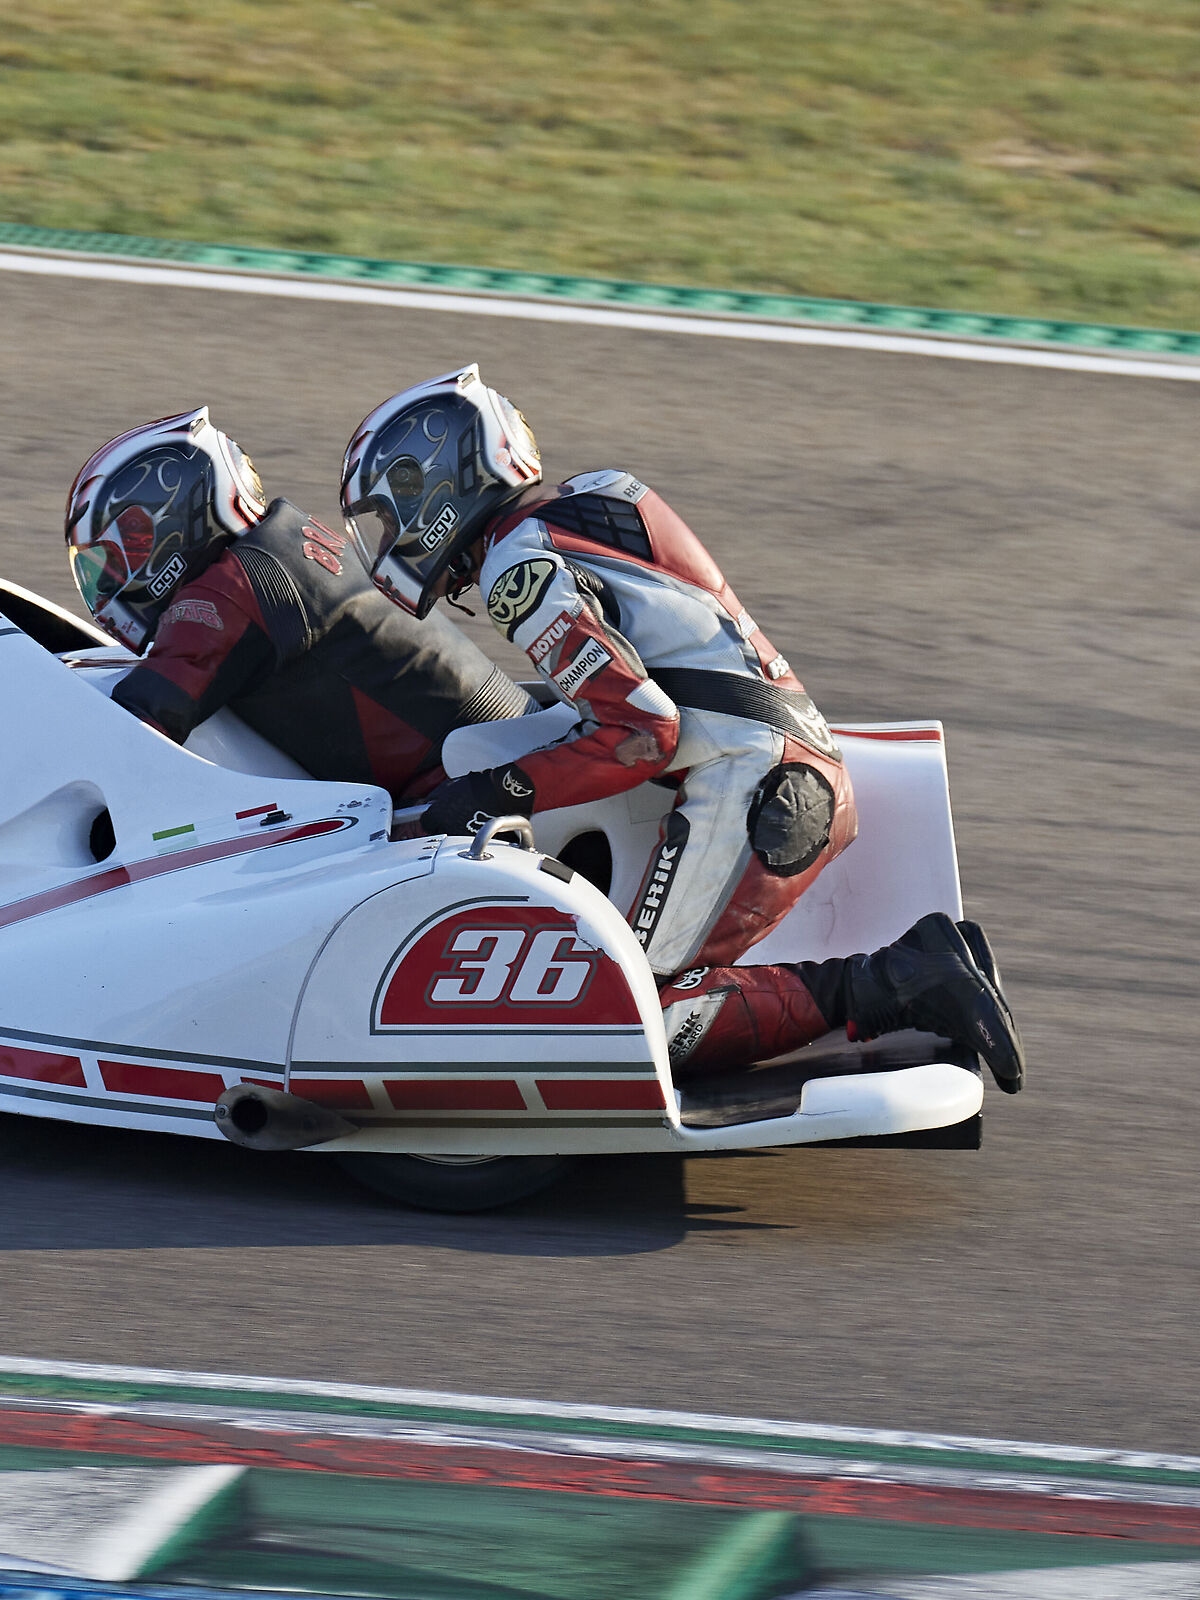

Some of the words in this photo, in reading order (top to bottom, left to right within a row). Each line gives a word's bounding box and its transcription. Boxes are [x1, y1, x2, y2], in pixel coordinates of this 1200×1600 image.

[426, 510, 452, 545] agv
[153, 561, 180, 593] agv
[530, 618, 572, 661] MOTUL
[559, 645, 604, 692] CHAMPION
[431, 930, 598, 1002] 36
[679, 1023, 704, 1058] OTARD
